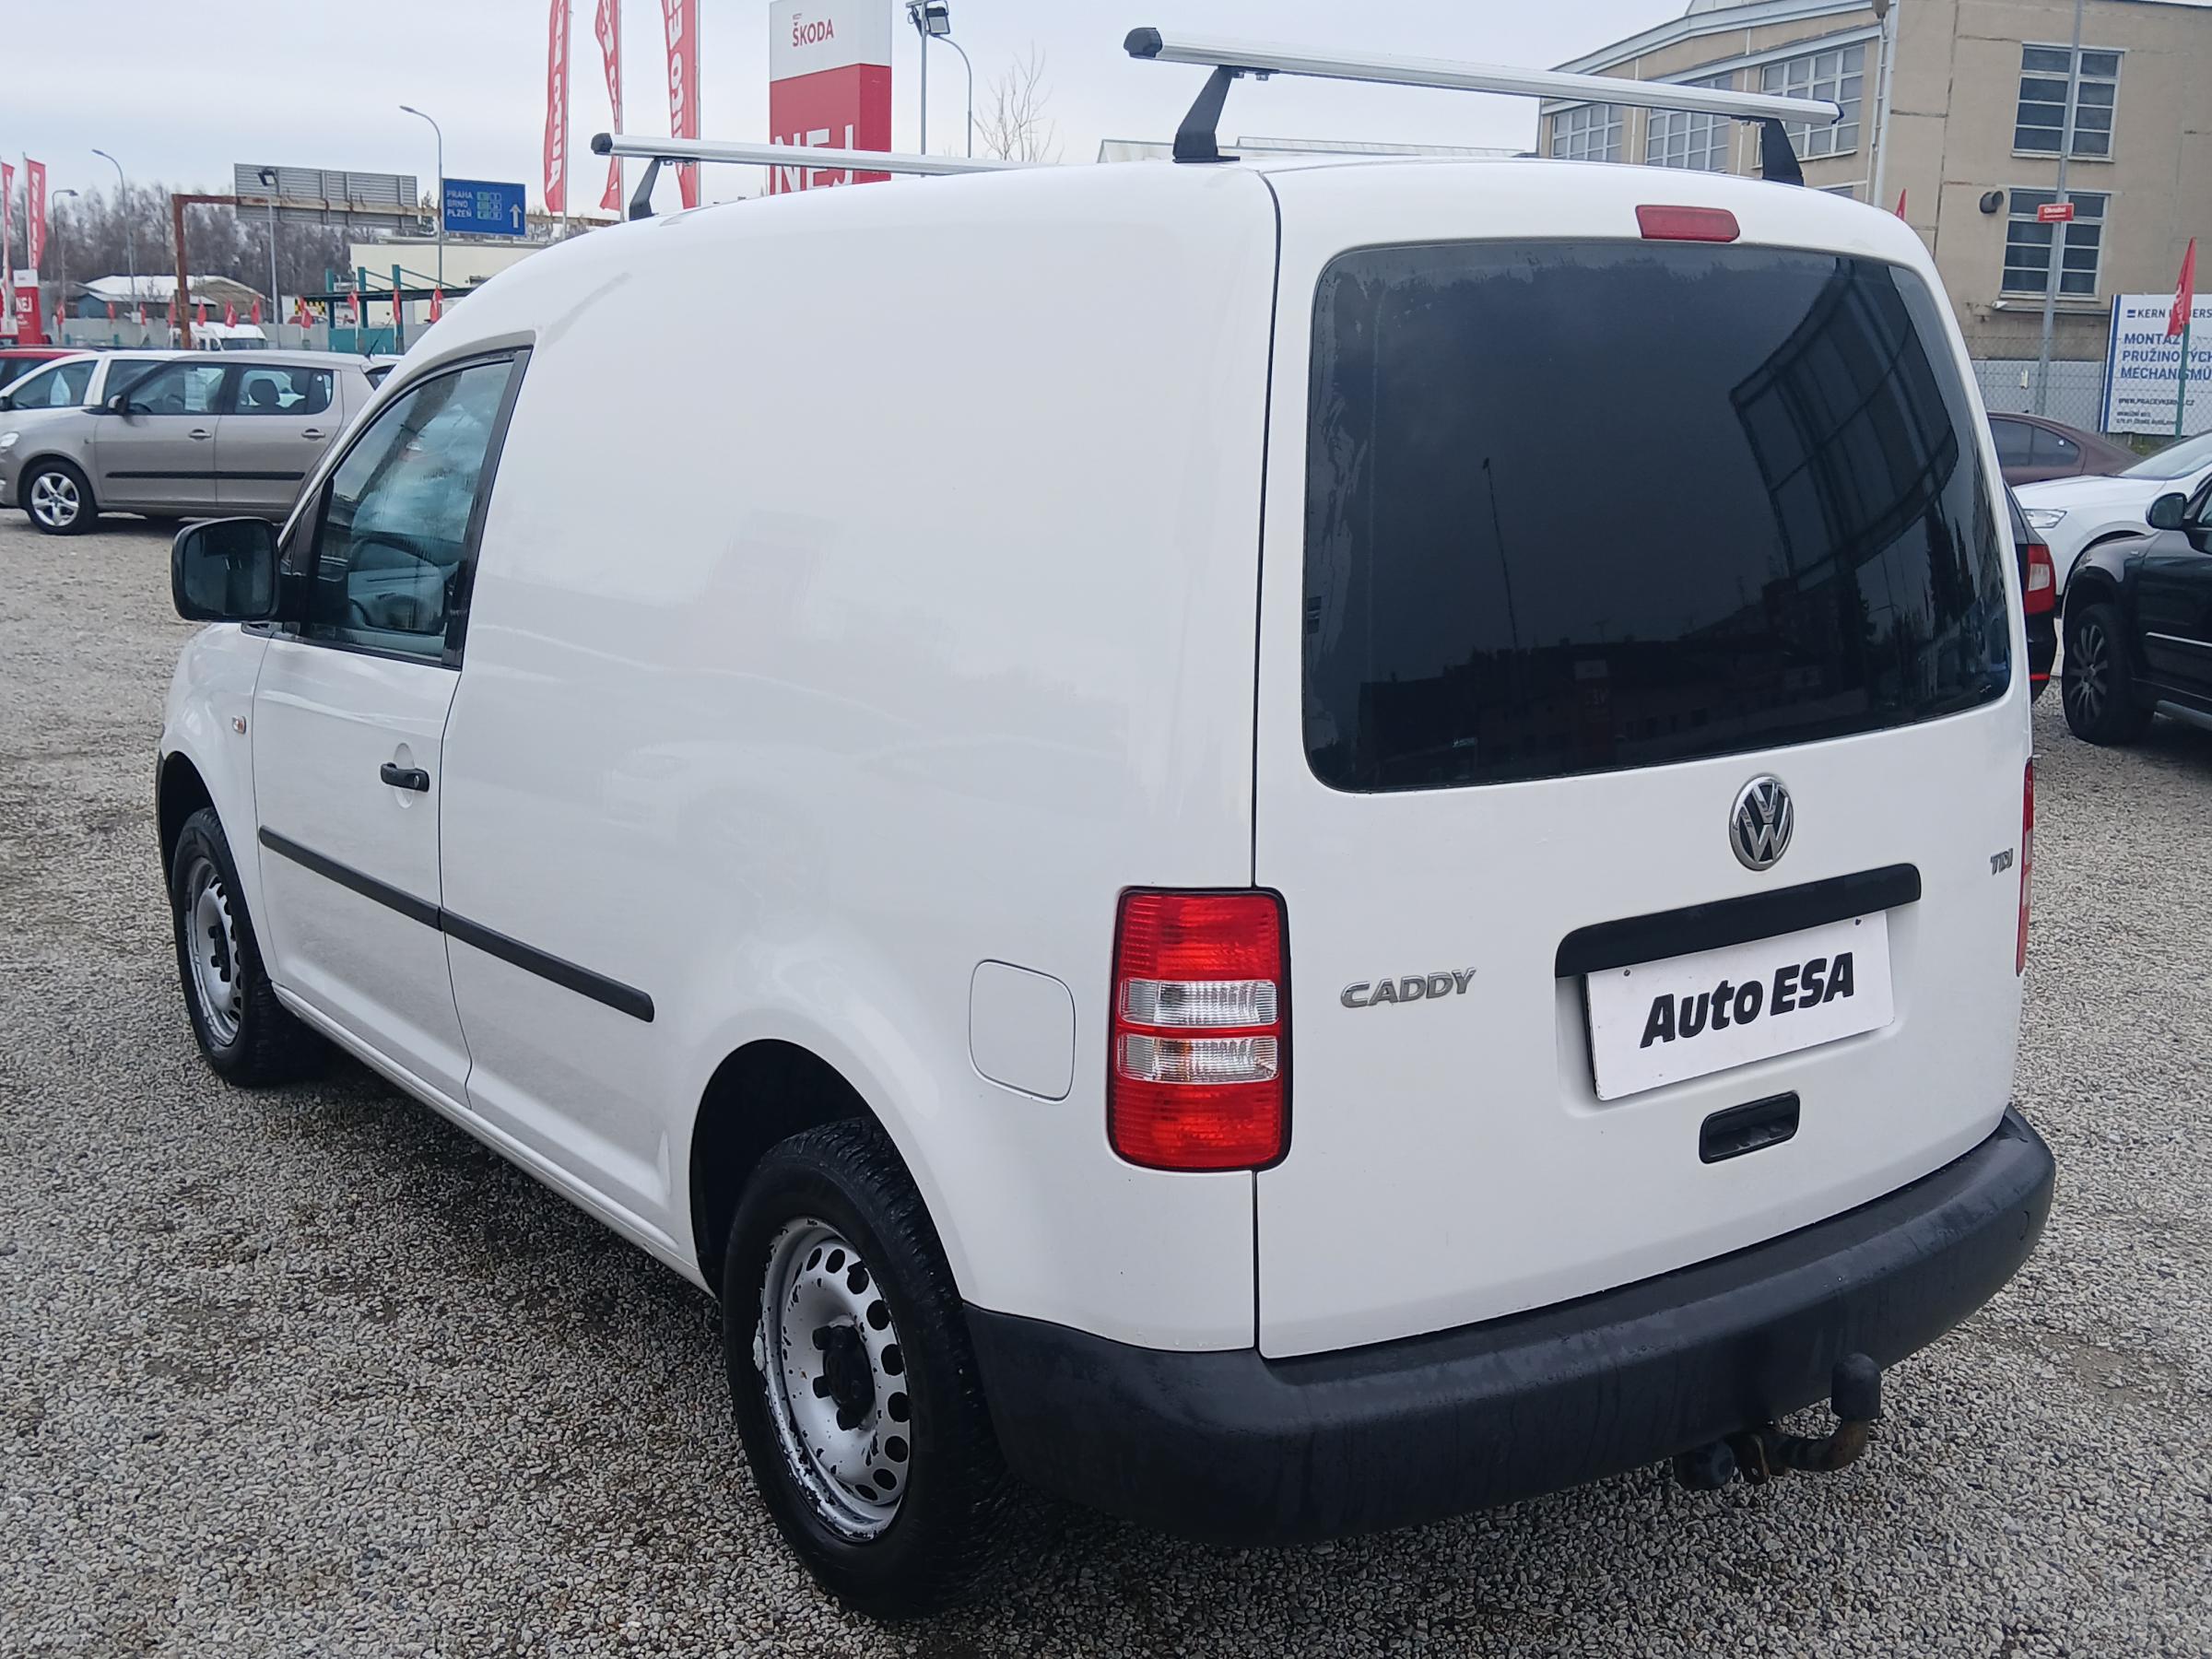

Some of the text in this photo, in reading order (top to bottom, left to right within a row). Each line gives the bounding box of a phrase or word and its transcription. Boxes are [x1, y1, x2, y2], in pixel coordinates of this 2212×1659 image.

[792, 18, 834, 47] ŠKODA
[2137, 308, 2166, 319] KERN
[1990, 848, 2014, 876] TDI
[1340, 968, 1476, 1009] CADDY
[1640, 951, 1854, 1049] Auto ESA
